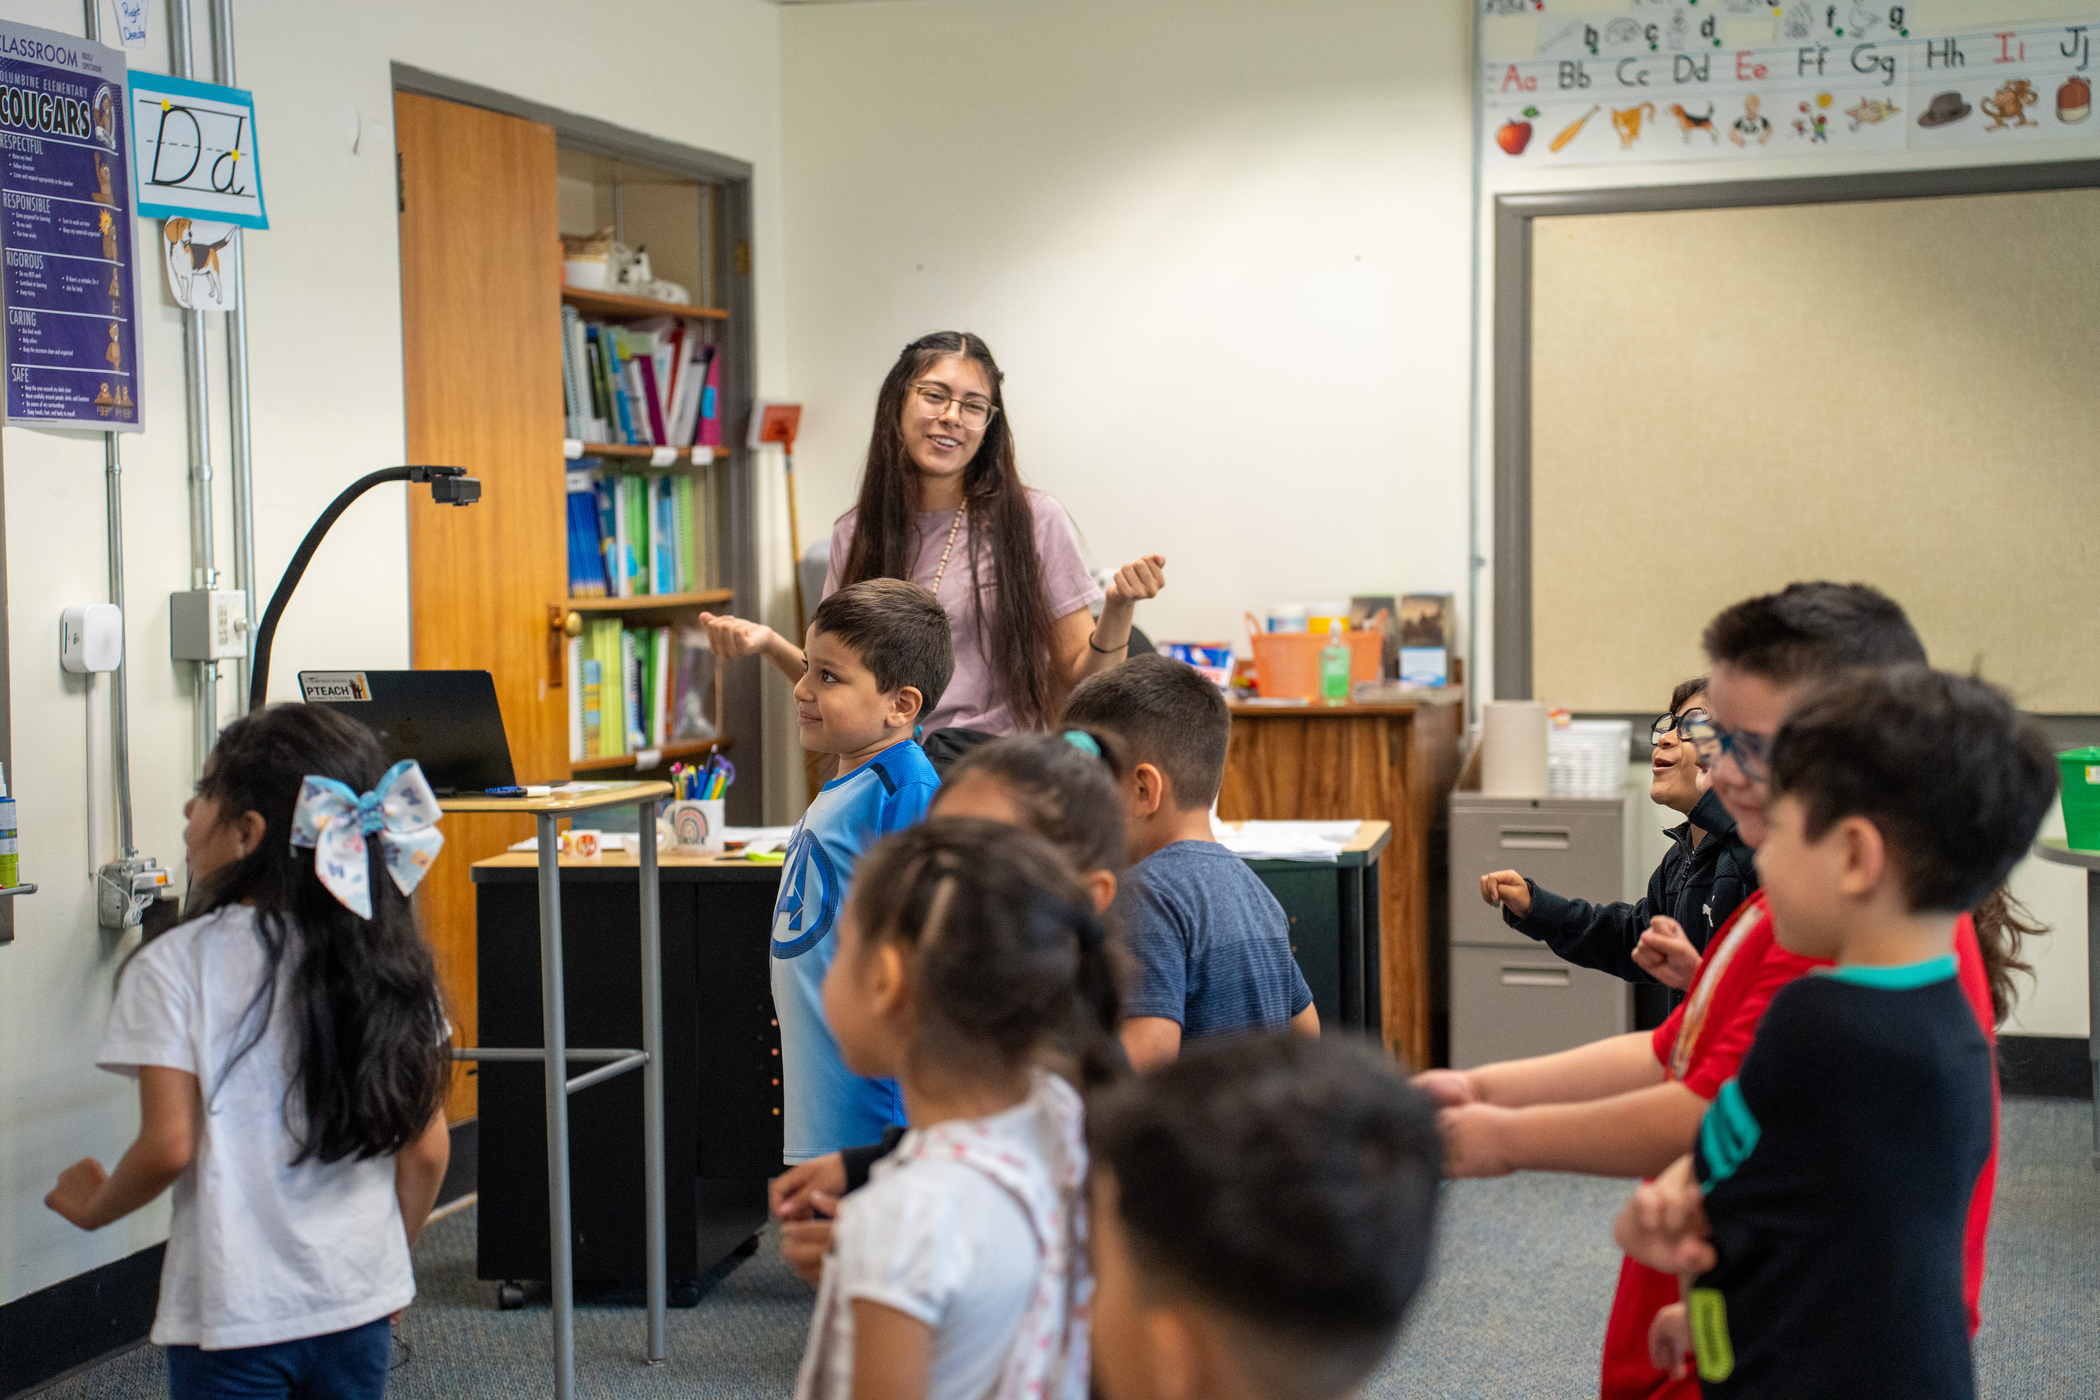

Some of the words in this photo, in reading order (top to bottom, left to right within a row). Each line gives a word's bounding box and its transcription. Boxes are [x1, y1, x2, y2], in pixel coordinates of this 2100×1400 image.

[1500, 64, 1538, 92] Aa
[1558, 60, 1592, 89] Bb
[1615, 57, 1650, 87] Cc
[1673, 53, 1710, 83] Dd
[1735, 50, 1769, 81] Ee
[1798, 44, 1830, 76] Ff
[1851, 43, 1895, 86] Gg
[1927, 37, 1965, 69] Hh
[43, 78, 88, 99] ELEMENTARY
[0, 85, 91, 139] COUGARS
[0, 133, 44, 155] RESPECTFUL
[2, 192, 51, 214] RESPONSIBLE
[6, 250, 44, 270] RIGOROUS
[9, 309, 37, 327] CARING
[11, 366, 29, 383] SAFE
[306, 686, 350, 696] PTEACH
